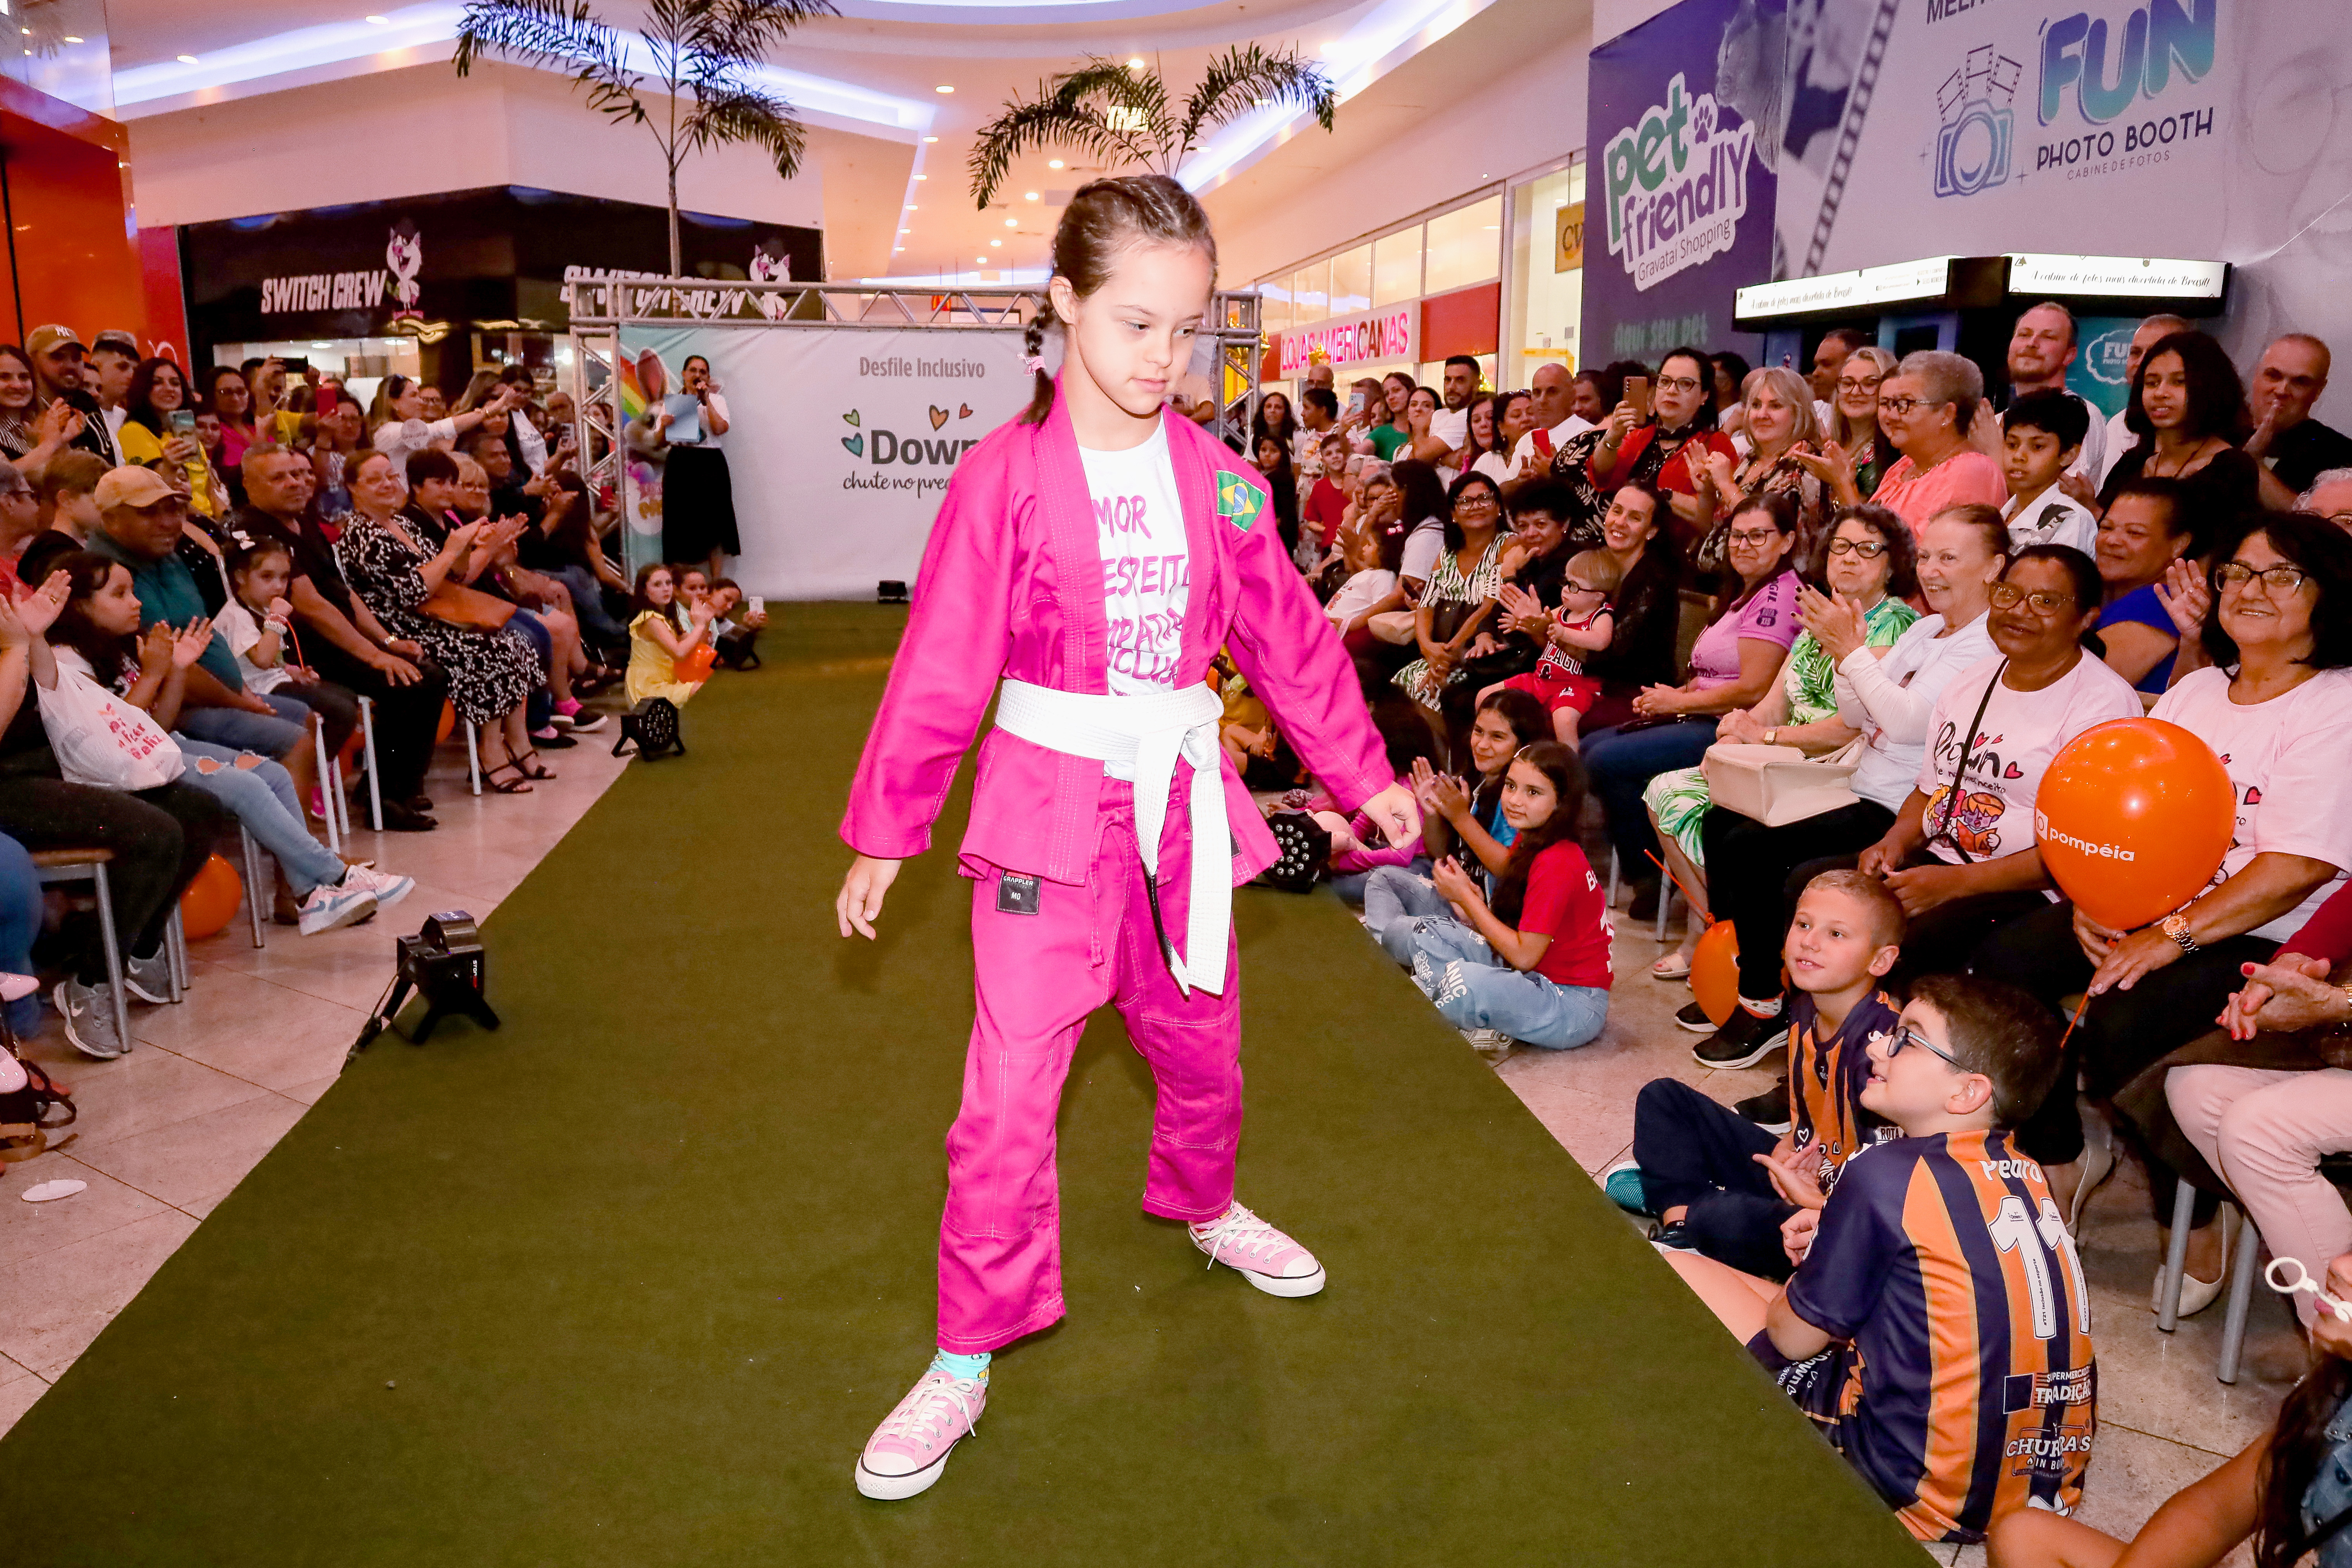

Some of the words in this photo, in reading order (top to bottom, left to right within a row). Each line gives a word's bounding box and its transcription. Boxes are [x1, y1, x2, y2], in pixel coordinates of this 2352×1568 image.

[2037, 0, 2217, 126] FUN
[2037, 132, 2114, 171] PHOTO
[2125, 107, 2213, 152] BOOTH
[1608, 85, 1688, 244] pet
[2067, 163, 2109, 180] CABINE
[2111, 160, 2126, 172] DE
[2129, 151, 2171, 168] FOTOS
[1680, 219, 1730, 258] Shopping
[261, 274, 331, 313] SWITCH
[332, 269, 387, 310] CREW
[2082, 273, 2102, 284] fotos
[2105, 275, 2125, 284] mais
[2128, 275, 2166, 285] divertida
[2182, 275, 2210, 287] Brasil!
[860, 357, 912, 377] Desfile
[917, 357, 985, 378] Inclusivo
[843, 471, 890, 490] chute
[893, 477, 916, 489] no
[1091, 495, 1152, 540] MOR
[2050, 827, 2135, 861] pompéia
[1003, 876, 1033, 886] GRAPPLER
[1881, 1127, 1900, 1141] ROTA
[1987, 1195, 2090, 1339] 11
[2033, 1258, 2041, 1279] esporte
[2038, 1279, 2042, 1288] no
[2035, 1376, 2091, 1405] TRADIÇÃO
[2035, 1458, 2046, 1468] IN
